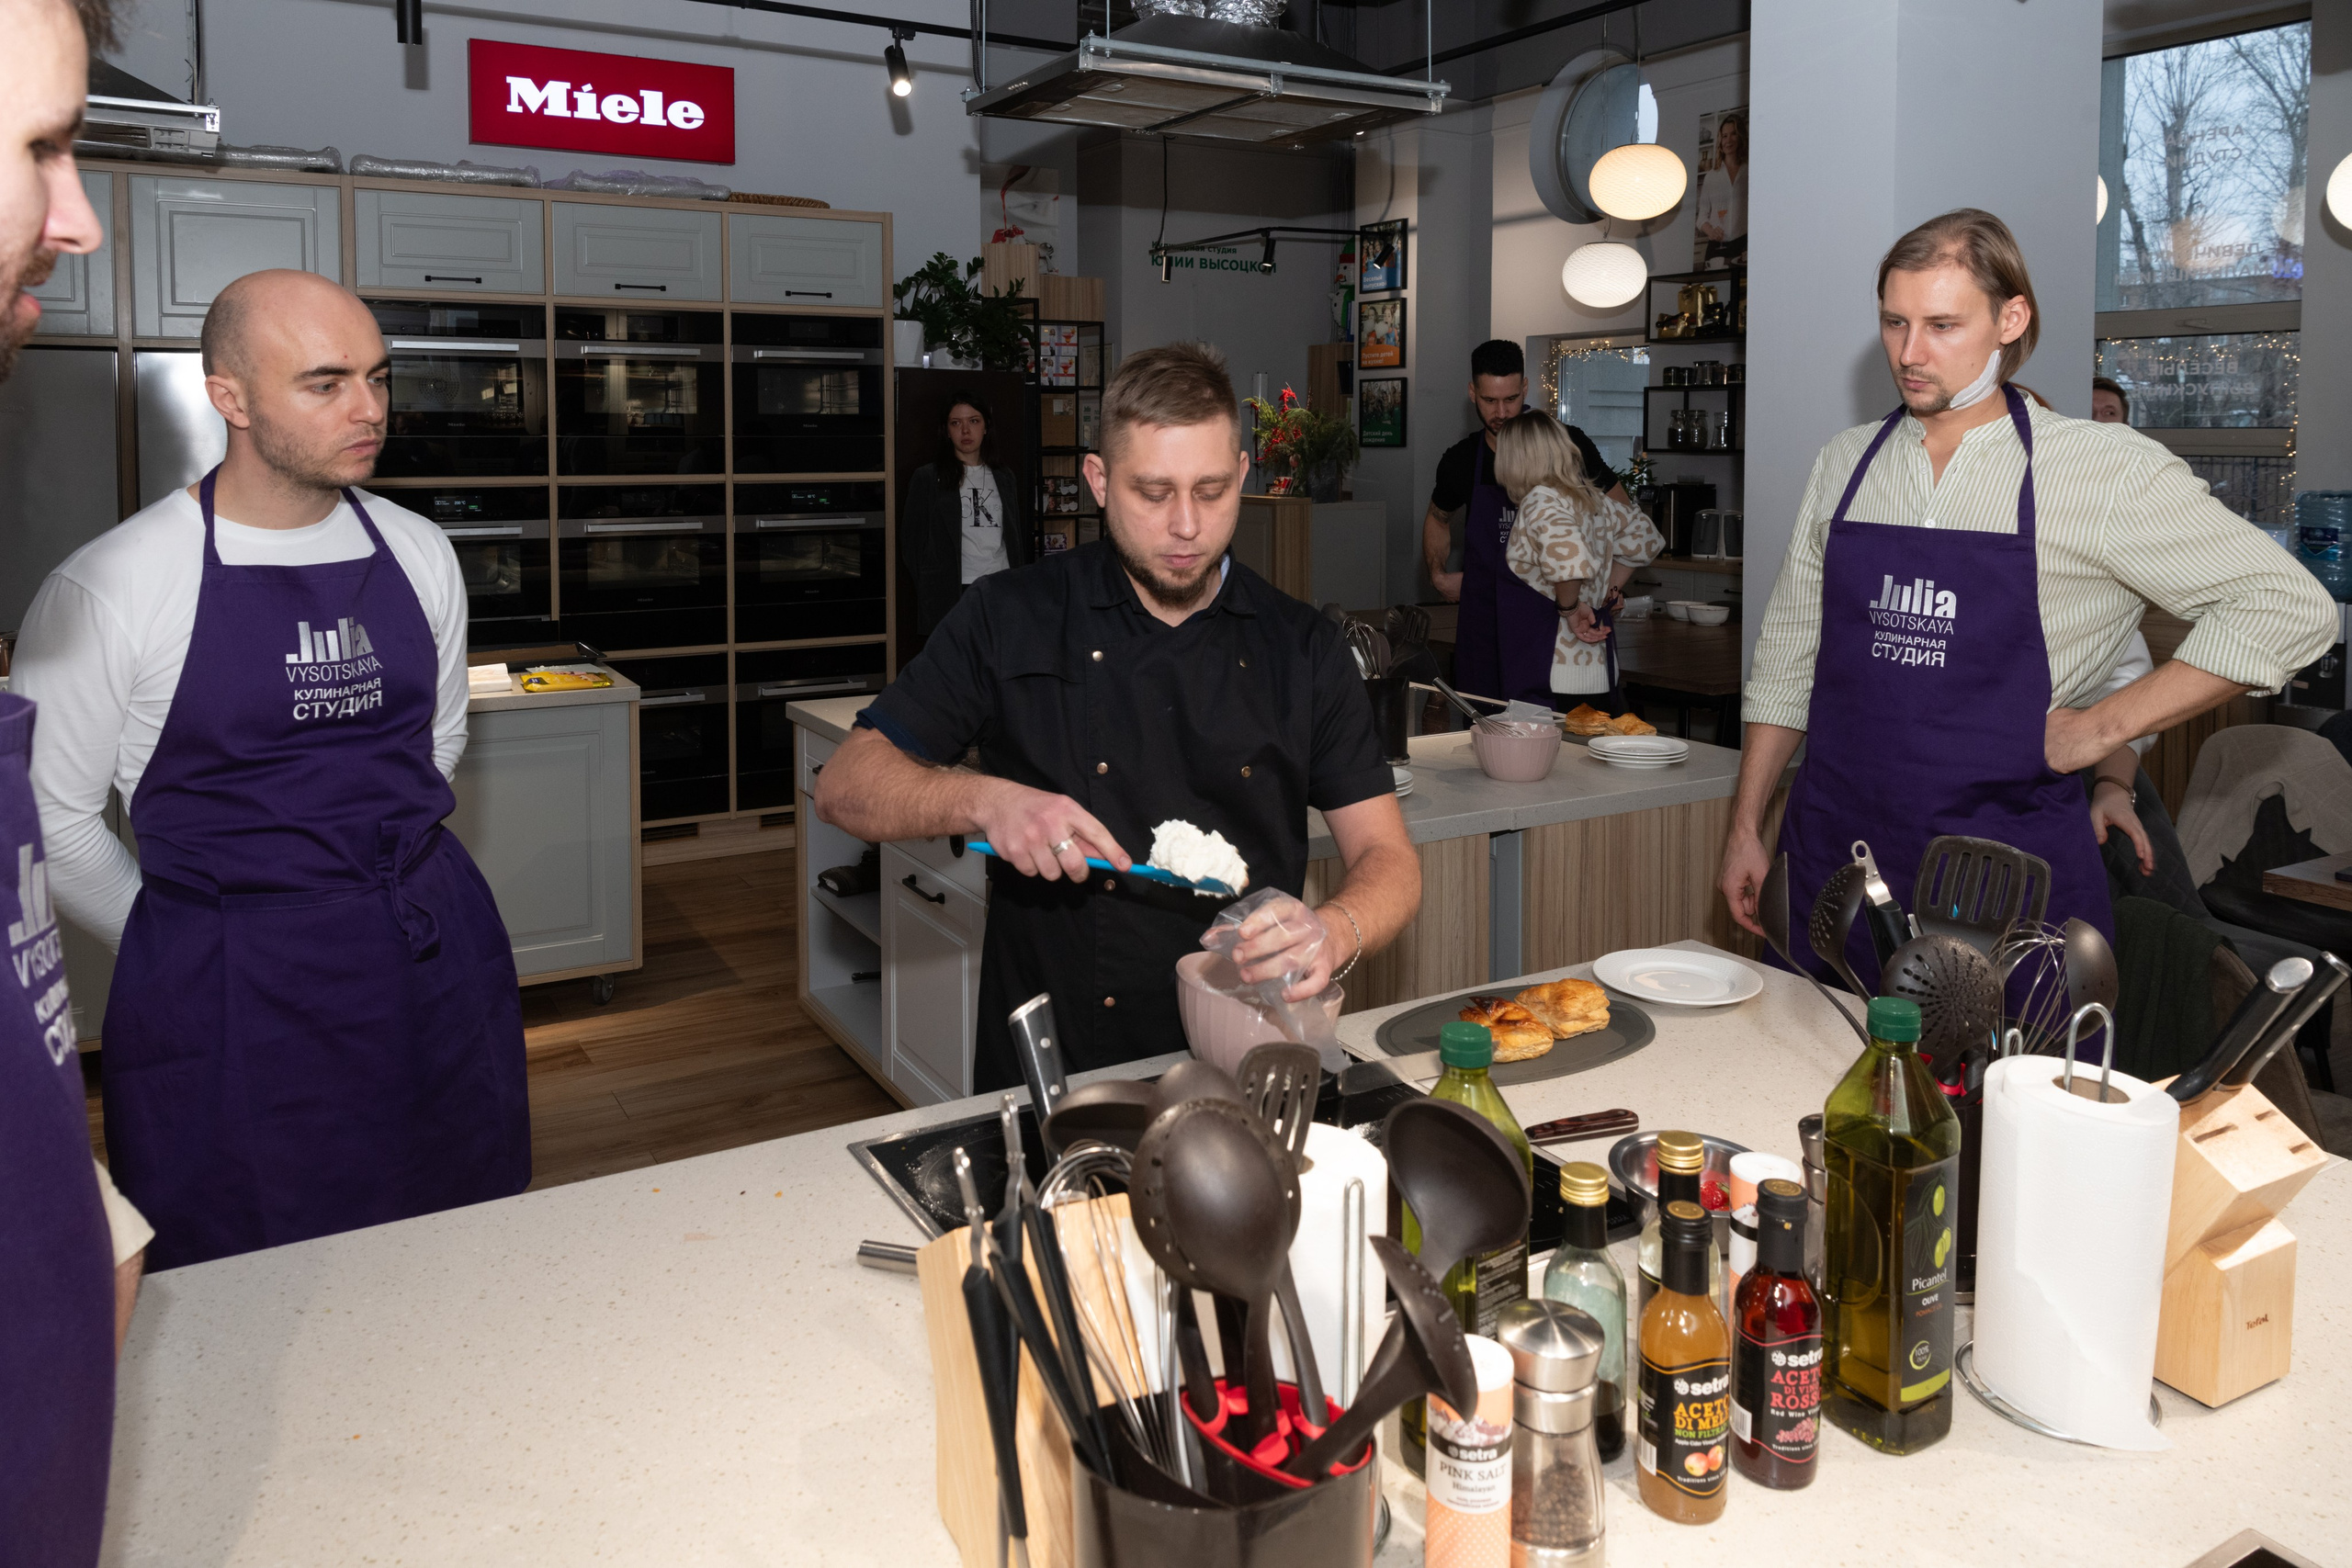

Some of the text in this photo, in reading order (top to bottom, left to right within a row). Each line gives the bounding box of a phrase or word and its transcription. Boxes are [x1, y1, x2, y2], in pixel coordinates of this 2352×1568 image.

[506, 75, 705, 130] Miele
[1869, 574, 1957, 619] Julia
[1869, 610, 1954, 635] VYSOTSKAYA
[286, 616, 374, 663] Julia
[1874, 630, 1947, 650] КУЛИНАРНАЯ
[1871, 642, 1946, 668] СТУДИЯ
[286, 655, 383, 682] VYSOTSKAYA
[294, 677, 382, 701] КУЛИНАРНАЯ
[293, 690, 383, 720] СТУДИЯ
[1912, 1267, 1947, 1292] Picantel
[1921, 1293, 1939, 1306] OLIVE
[2246, 1313, 2269, 1331] Tefal
[1784, 1385, 1796, 1396] DI
[1770, 1408, 1785, 1417] Red
[1675, 1416, 1693, 1430] DI
[1675, 1427, 1696, 1438] NON
[1459, 1448, 1498, 1461] setra
[1440, 1461, 1506, 1481] PINK SALT
[1452, 1482, 1496, 1495] Himalayan
